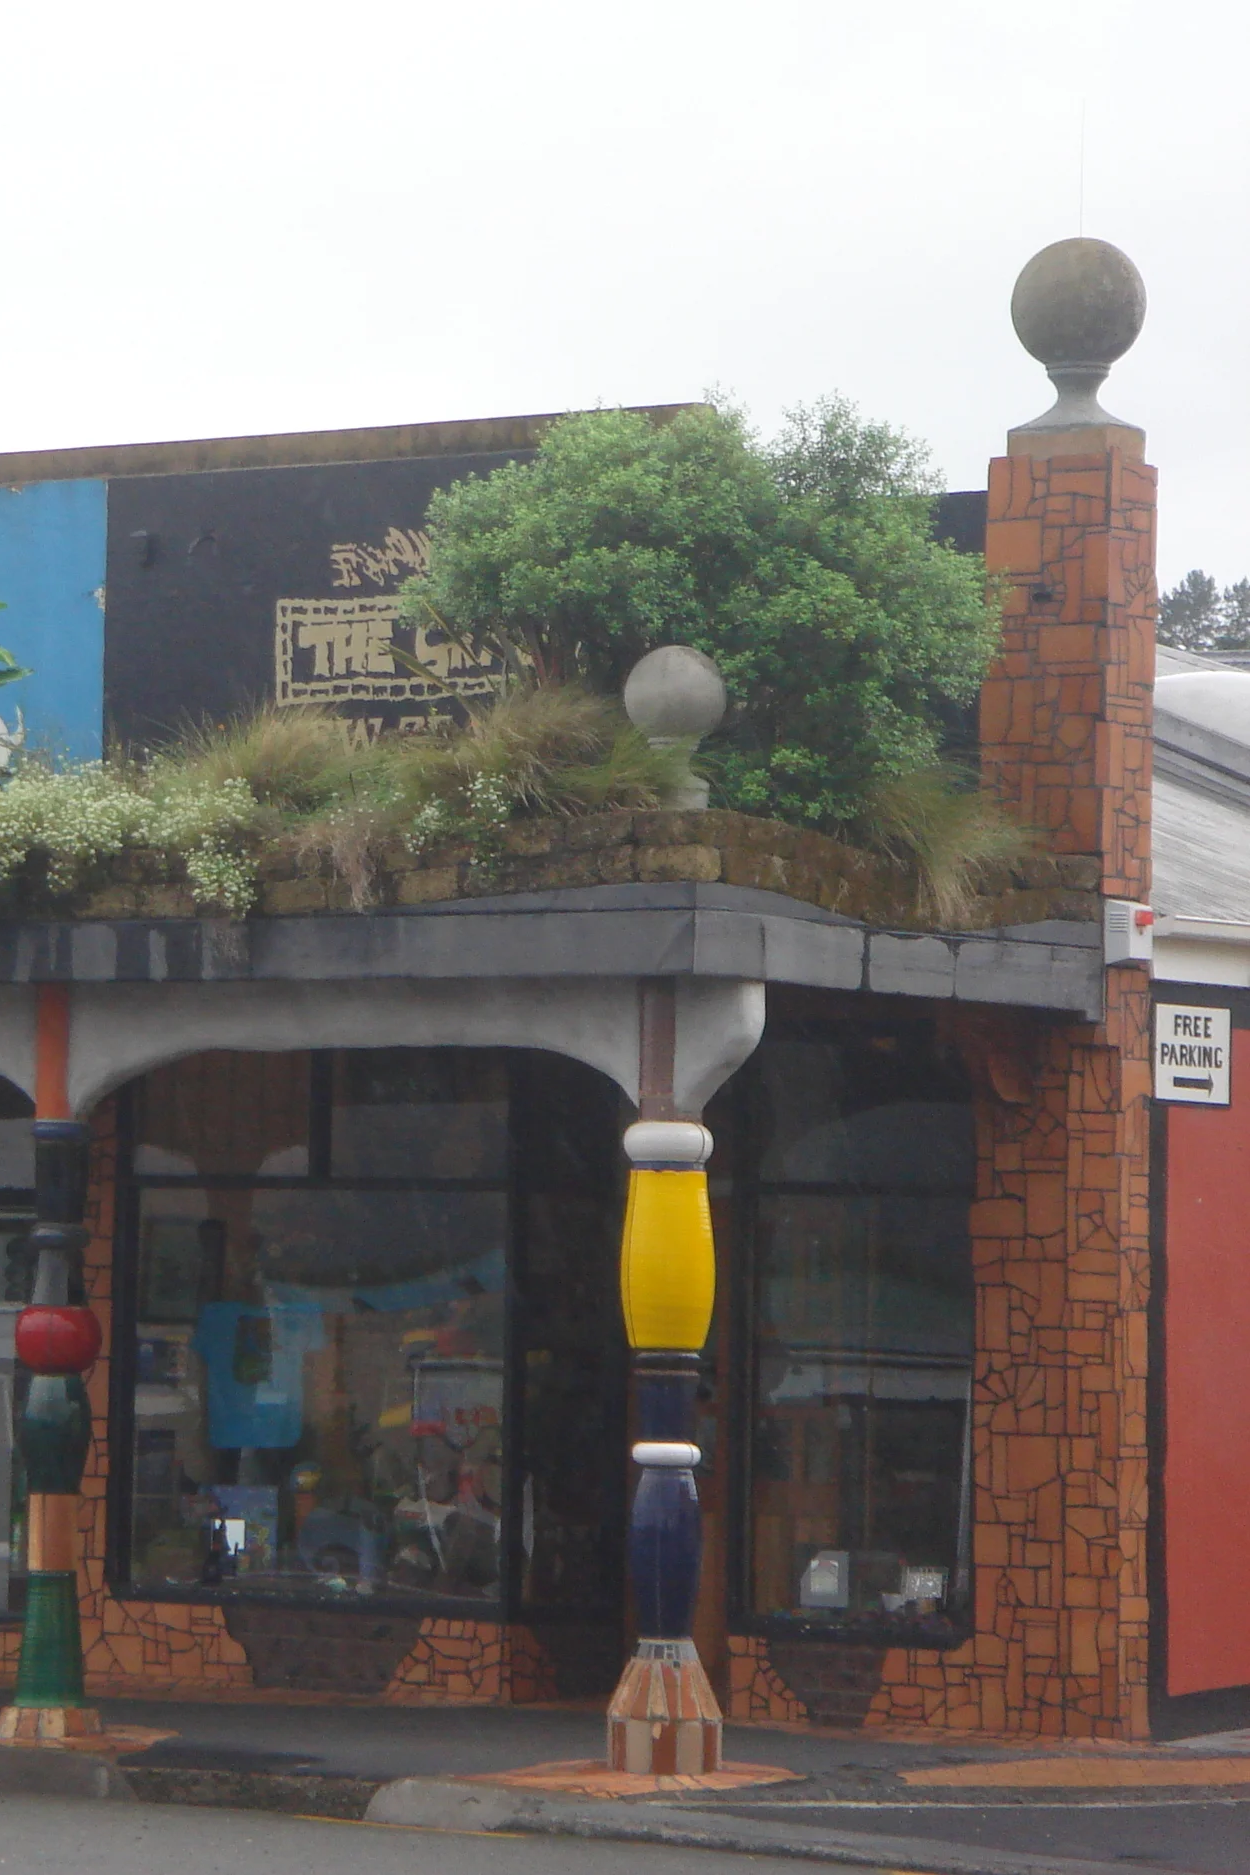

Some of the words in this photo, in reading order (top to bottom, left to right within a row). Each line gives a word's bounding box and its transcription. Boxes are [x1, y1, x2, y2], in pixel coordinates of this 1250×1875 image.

[299, 621, 395, 676] THE
[1174, 1014, 1213, 1038] FREE
[1160, 1042, 1223, 1069] PARKING
